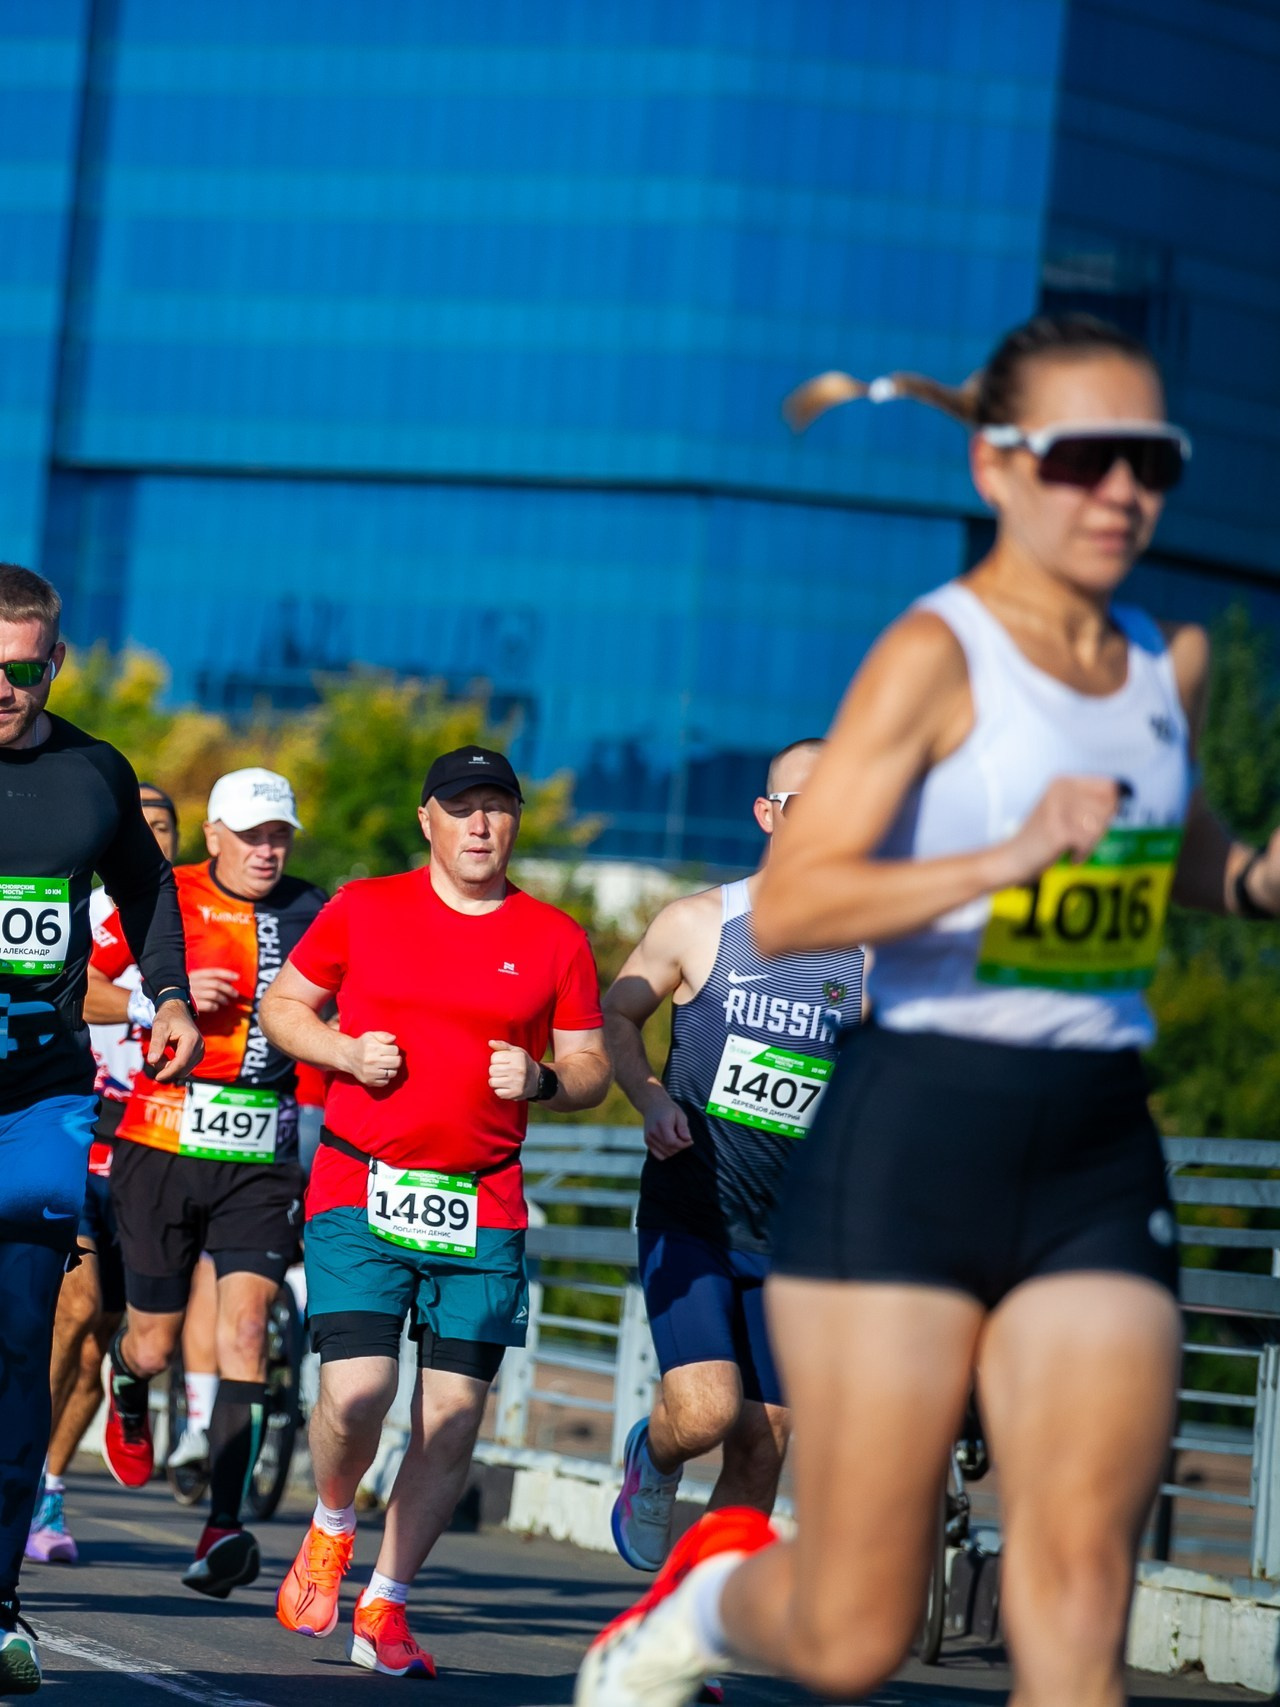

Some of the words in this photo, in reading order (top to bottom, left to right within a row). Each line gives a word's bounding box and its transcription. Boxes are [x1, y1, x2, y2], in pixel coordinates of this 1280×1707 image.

[1009, 877, 1152, 943] 1016
[2, 947, 51, 956] АЛЕКСАНДР
[722, 987, 843, 1044] RUSSIA
[722, 1064, 822, 1114] 1407
[191, 1107, 271, 1140] 1497
[731, 1098, 768, 1113] ДЕРЕВЦОВ
[768, 1109, 801, 1121] ДМИТРИЙ
[375, 1190, 470, 1231] 1489
[392, 1225, 427, 1235] ЛОПАТИН
[427, 1229, 452, 1238] ДЕНИС
